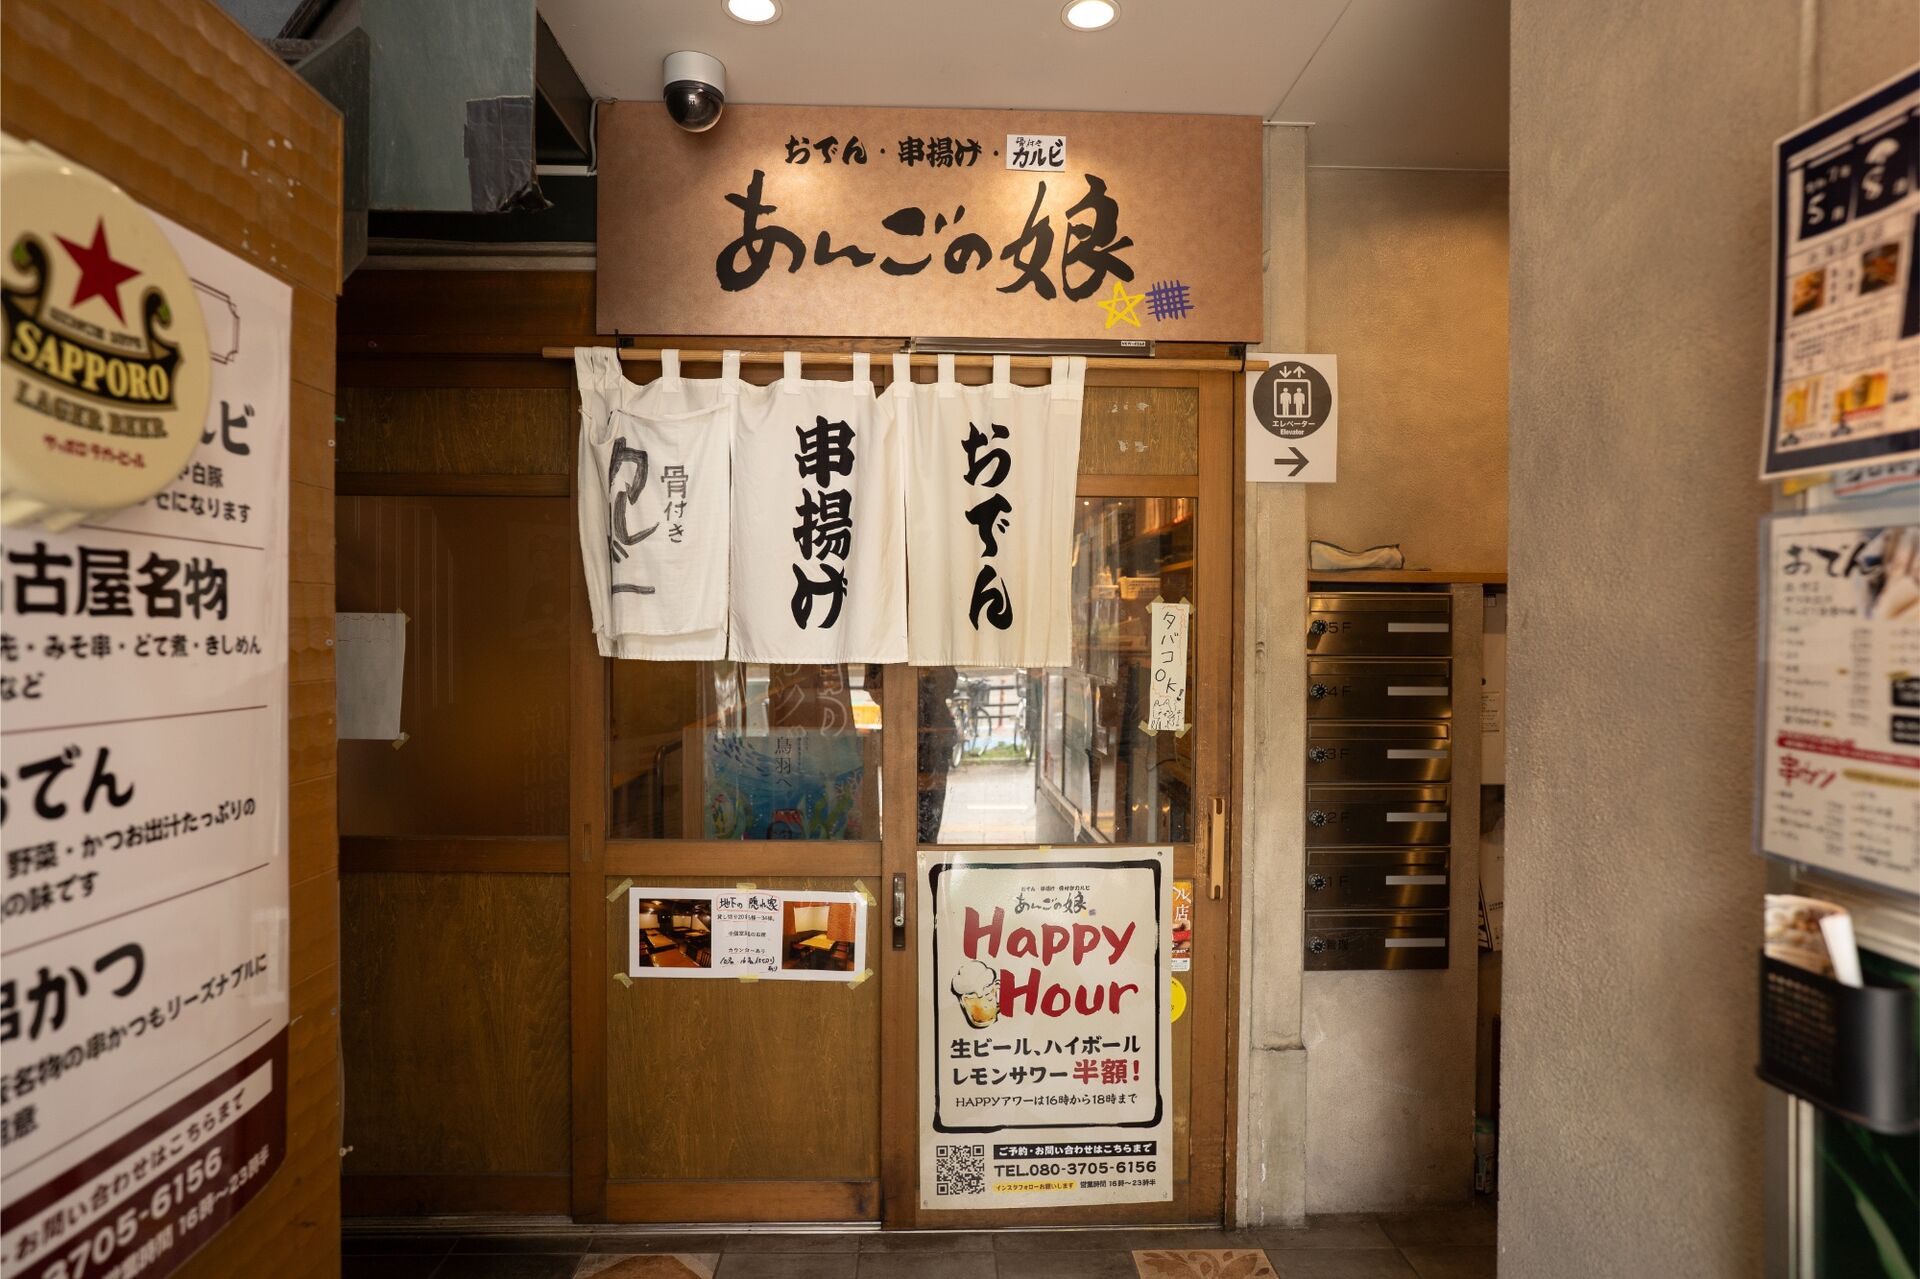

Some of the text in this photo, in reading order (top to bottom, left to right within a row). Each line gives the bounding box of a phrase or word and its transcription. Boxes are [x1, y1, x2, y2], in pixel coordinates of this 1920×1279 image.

[1012, 138, 1065, 168] カルビ
[715, 169, 1135, 302] あんごの娘
[11, 321, 169, 400] SAPPORO
[13, 379, 168, 438] LAGER BEER
[1272, 420, 1316, 428] エレベーター
[1280, 428, 1304, 436] Elevator
[660, 464, 689, 544] 骨付き
[790, 415, 856, 630] 串揚げ
[961, 422, 1014, 631] おでん
[0, 541, 228, 621] 古屋名物
[0, 744, 134, 826] でん
[0, 870, 98, 924] の味です
[1015, 891, 1087, 914] あんごの娘
[963, 906, 1136, 966] Happy
[999, 967, 1139, 1018] Hour
[950, 1035, 1141, 1059] 生ビール、ハイボール
[956, 1093, 1138, 1107] HAPPYアワーは16時から18時まで
[993, 1160, 1157, 1178] TEL.080-3705-6156
[998, 1143, 1152, 1156] ご予約・お問い合わせはこちらまで
[996, 1181, 1075, 1191] インスタフォローお願いします
[1080, 1180, 1107, 1188] 営業時間
